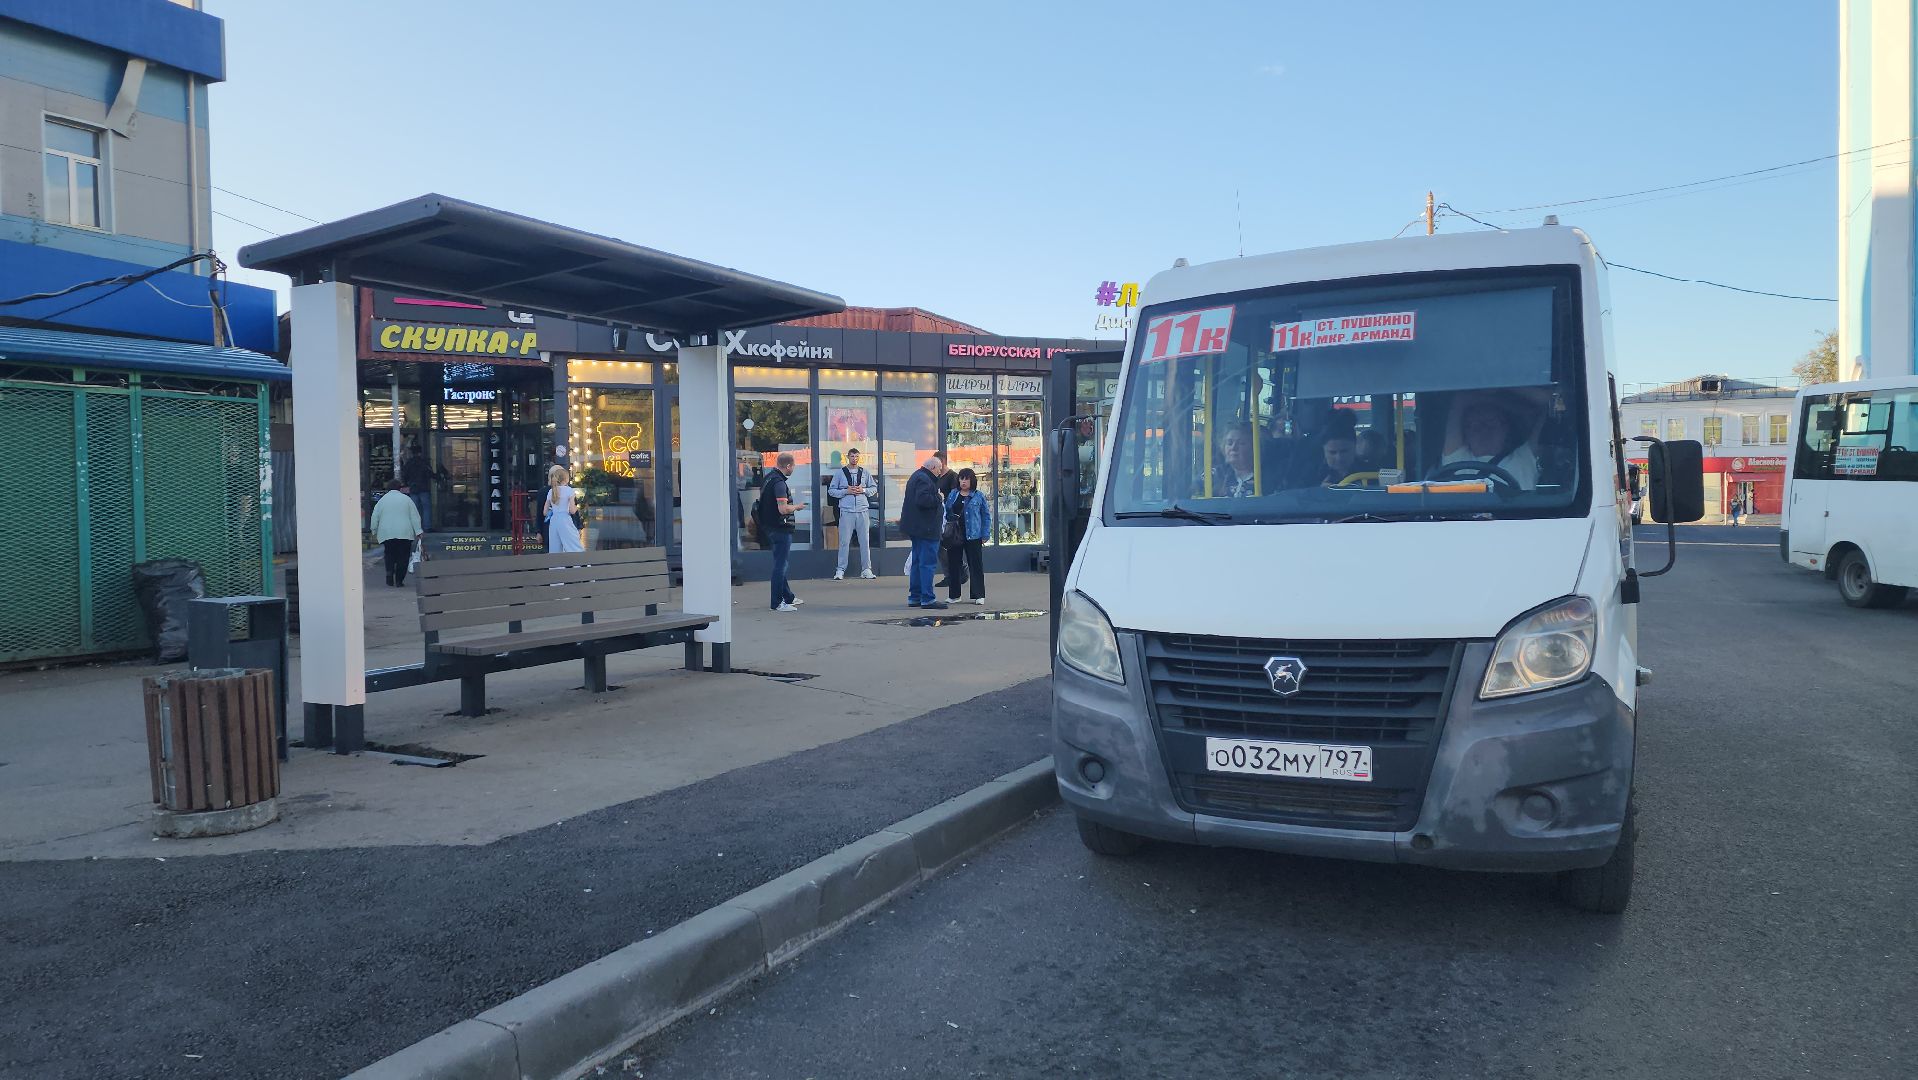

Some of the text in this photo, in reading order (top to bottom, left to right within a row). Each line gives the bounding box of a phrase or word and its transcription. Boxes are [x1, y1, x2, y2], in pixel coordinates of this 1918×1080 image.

[1341, 314, 1412, 329] ПУШКИНО
[1316, 328, 1411, 344] МКР. АРМАНД
[746, 340, 833, 363] кофейня
[949, 343, 1041, 359] БЕЛОРУССКАЯ
[1321, 748, 1363, 770] 797
[1333, 768, 1354, 777] RUS
